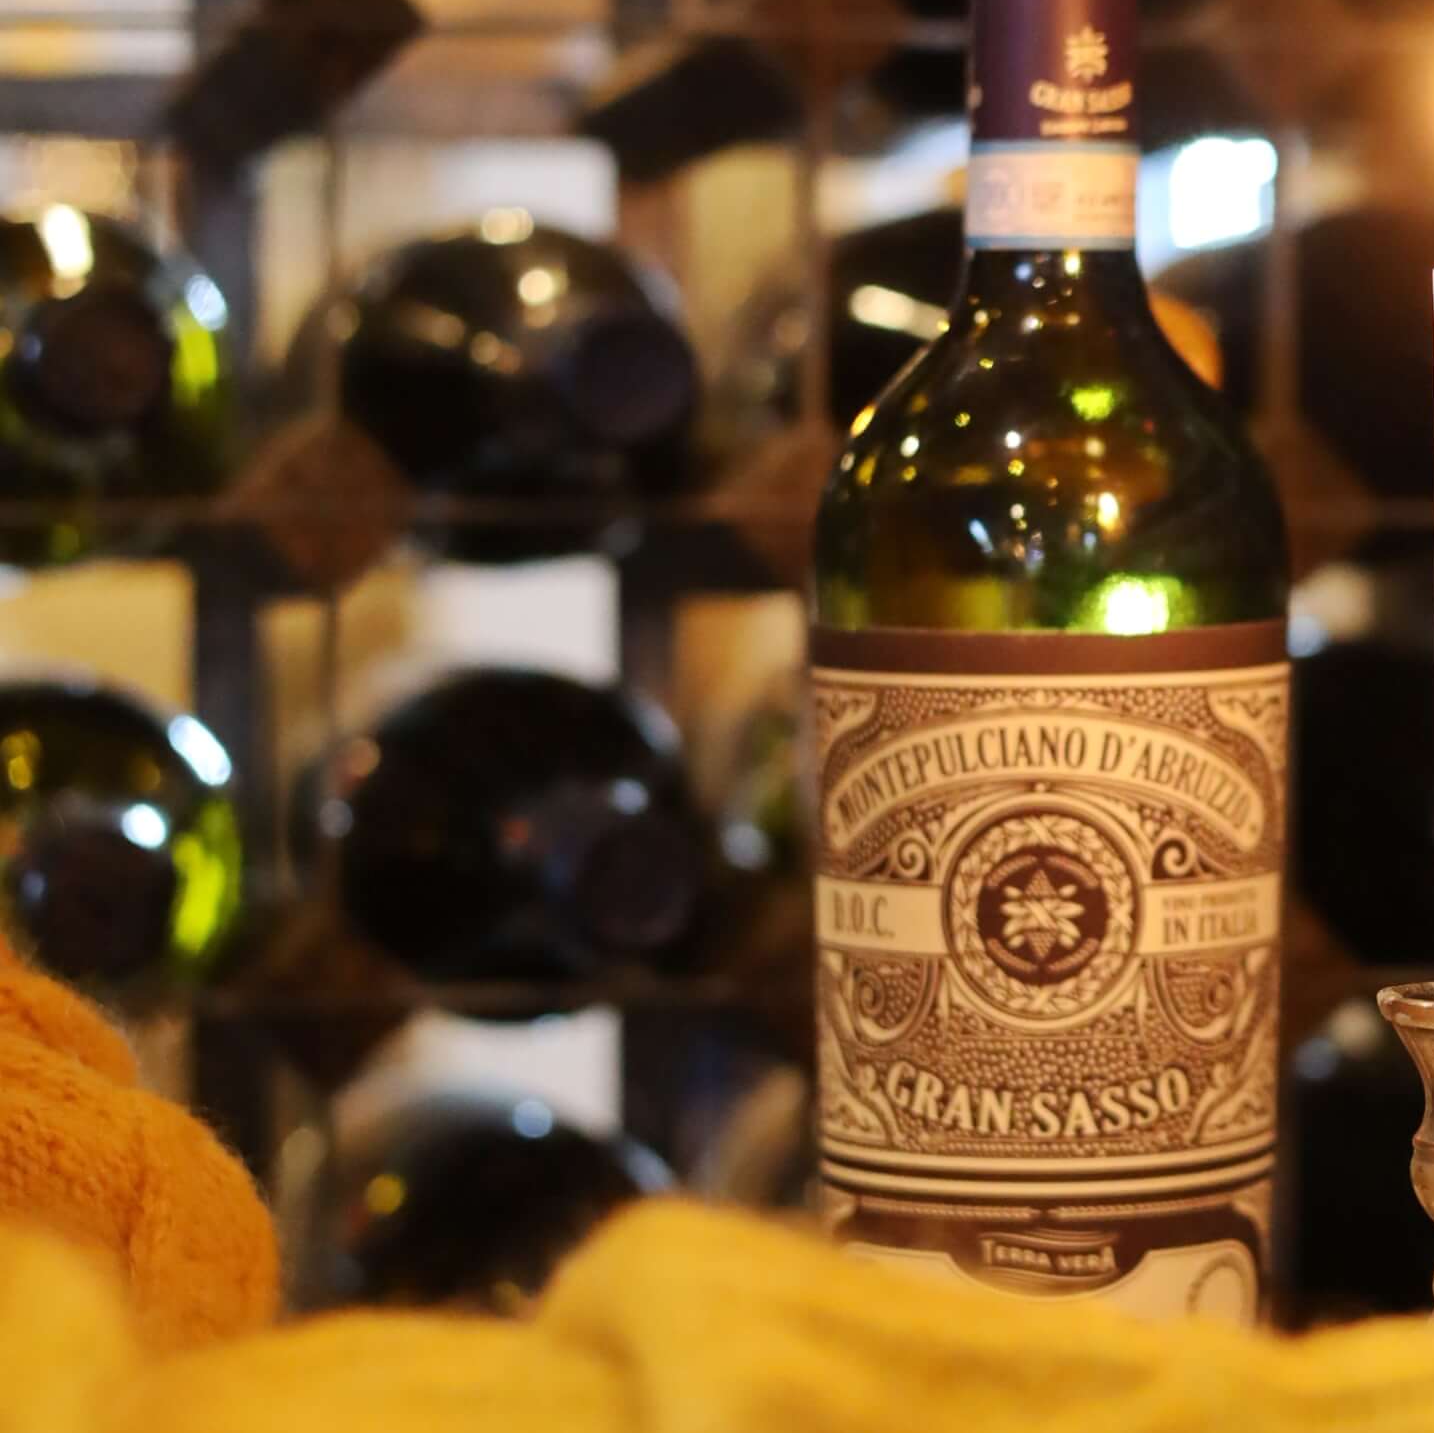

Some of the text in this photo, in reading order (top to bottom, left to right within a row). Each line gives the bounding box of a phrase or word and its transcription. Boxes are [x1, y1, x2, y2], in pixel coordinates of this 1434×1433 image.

[835, 725, 1254, 831] MONTEPULCIANO D'ABRUZZO
[1162, 914, 1189, 945] IN
[885, 1061, 1191, 1138] GRAN SASSO
